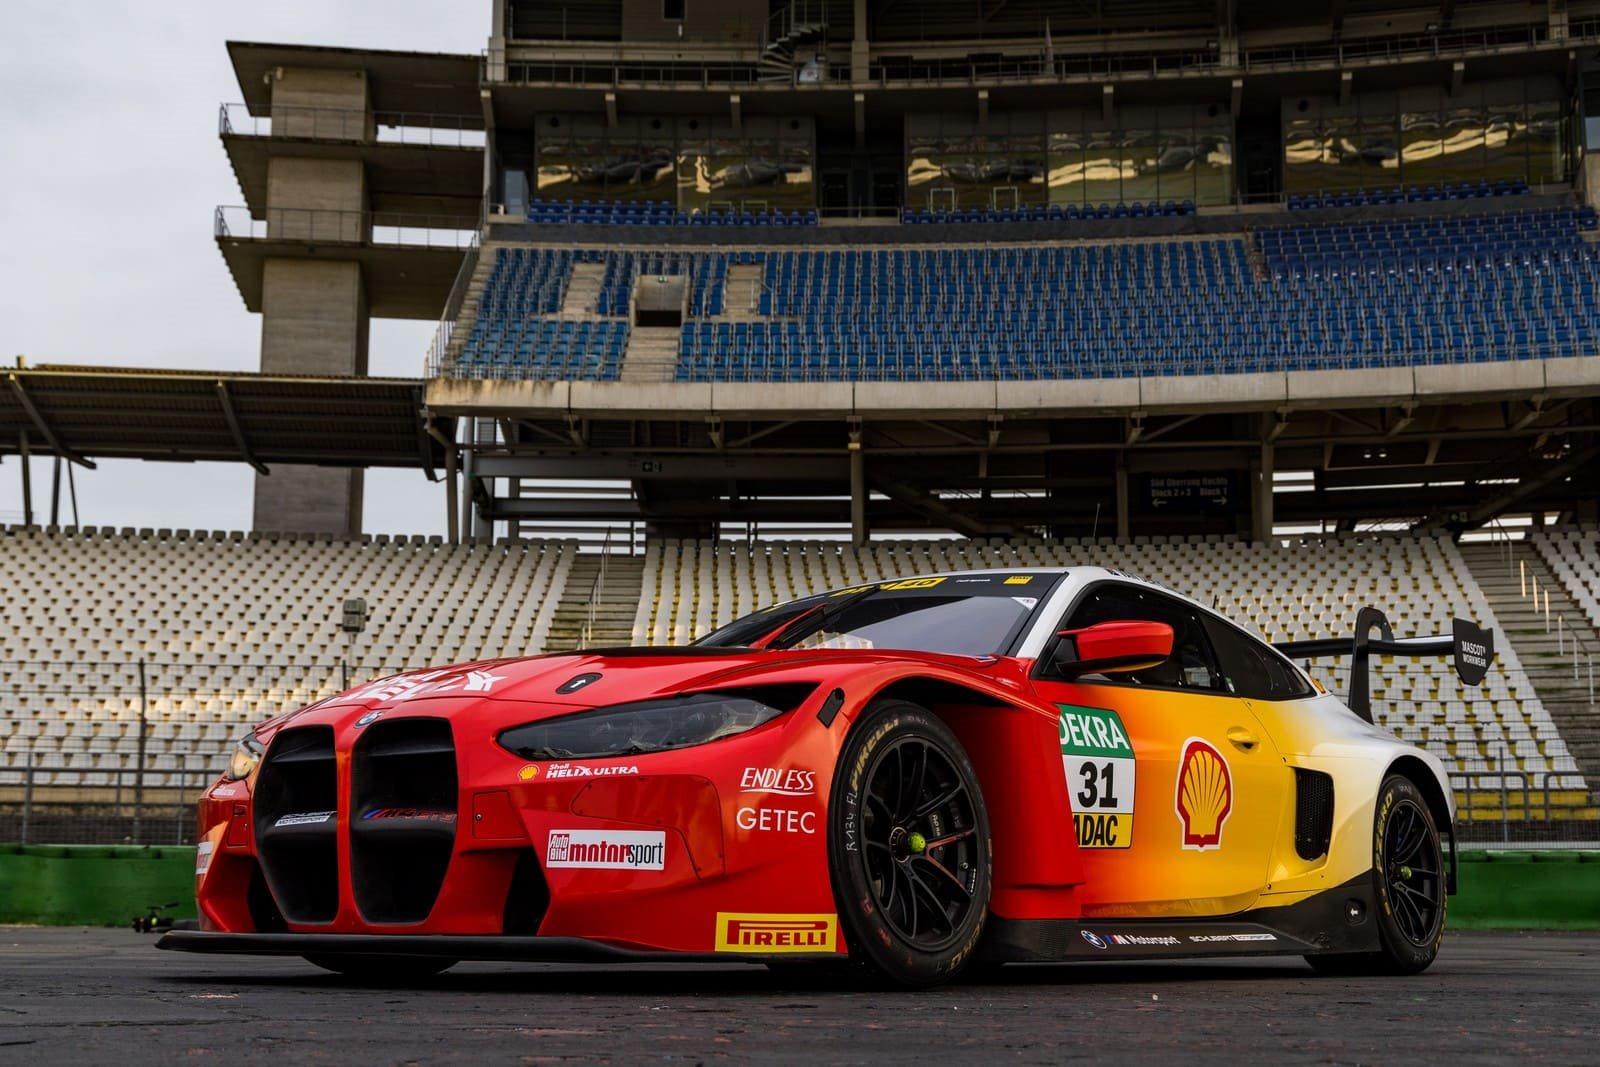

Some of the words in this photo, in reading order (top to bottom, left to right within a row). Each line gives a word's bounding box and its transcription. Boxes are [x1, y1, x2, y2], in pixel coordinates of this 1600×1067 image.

[546, 766, 593, 779] HELIX
[594, 766, 639, 776] ULTRA
[740, 767, 815, 792] ENDLESS
[1078, 761, 1118, 808] 31
[736, 807, 816, 834] GETEC
[550, 834, 569, 849] Auto
[549, 848, 567, 861] Bild
[727, 920, 828, 945] PIRELLI
